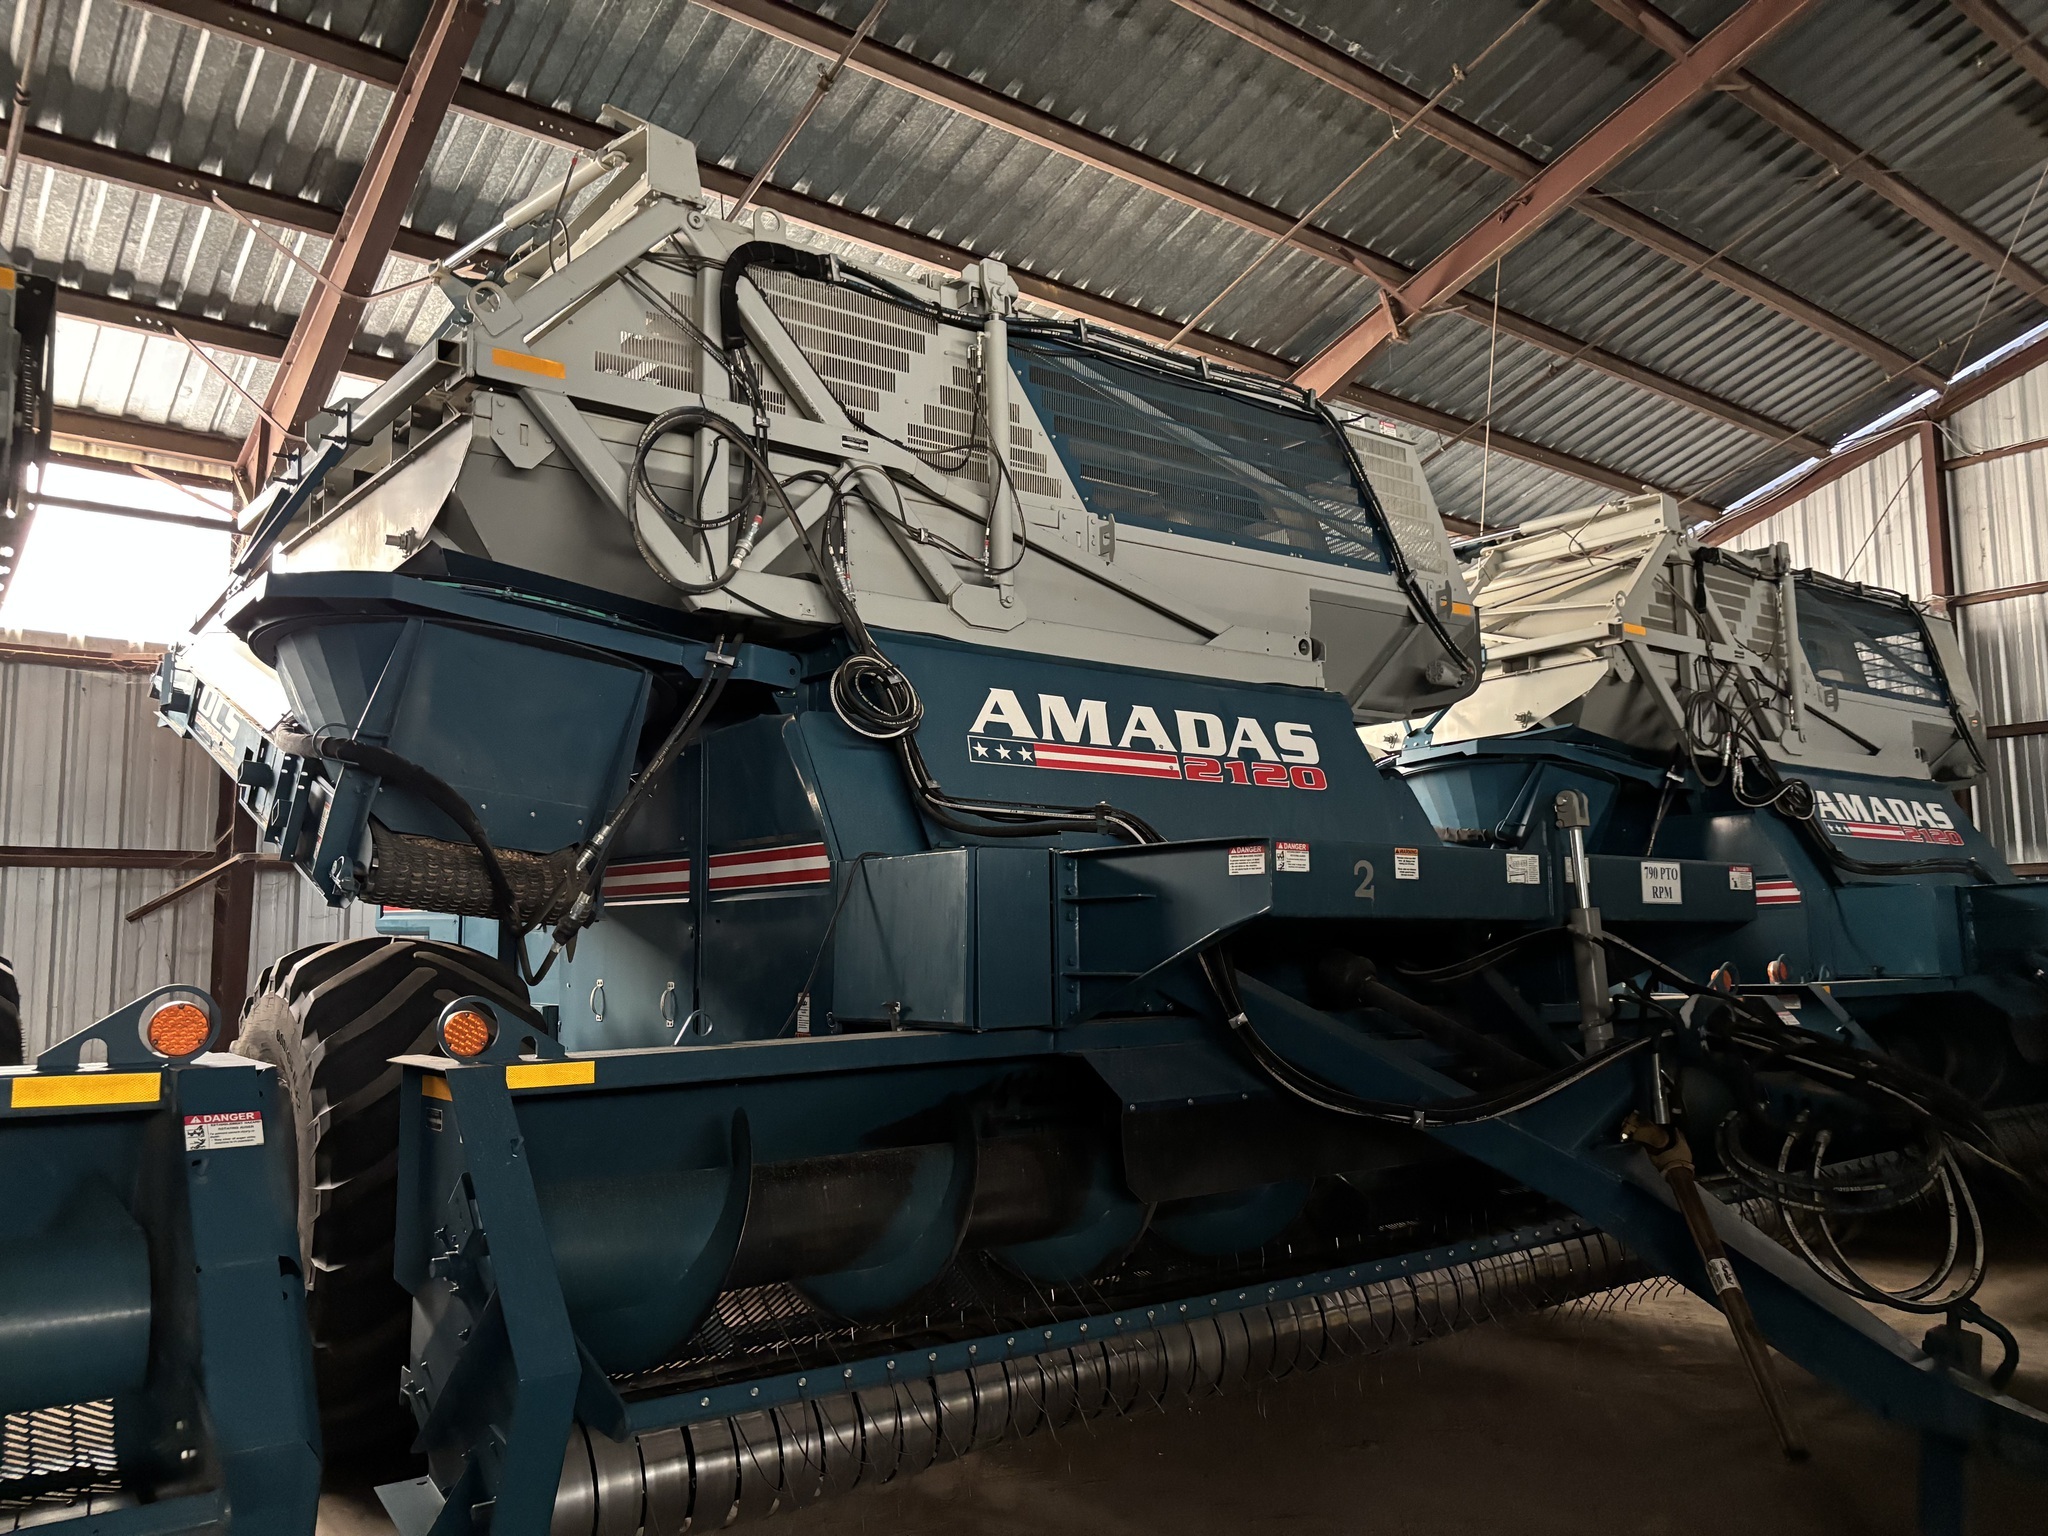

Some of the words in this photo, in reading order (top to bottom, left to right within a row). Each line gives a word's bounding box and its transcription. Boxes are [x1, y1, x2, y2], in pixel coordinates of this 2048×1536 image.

[968, 687, 1320, 766] AMADAS
[1182, 755, 1328, 791] 2120
[1815, 790, 1955, 830] AMADAS
[1901, 826, 1965, 846] 2120
[1235, 845, 1262, 855] DANGER
[1283, 842, 1307, 851] DANGER
[1353, 859, 1375, 899] 2
[1643, 866, 1658, 880] 790
[1660, 867, 1678, 880] PTO
[1652, 885, 1673, 899] RPM
[203, 1111, 255, 1123] DANGER
